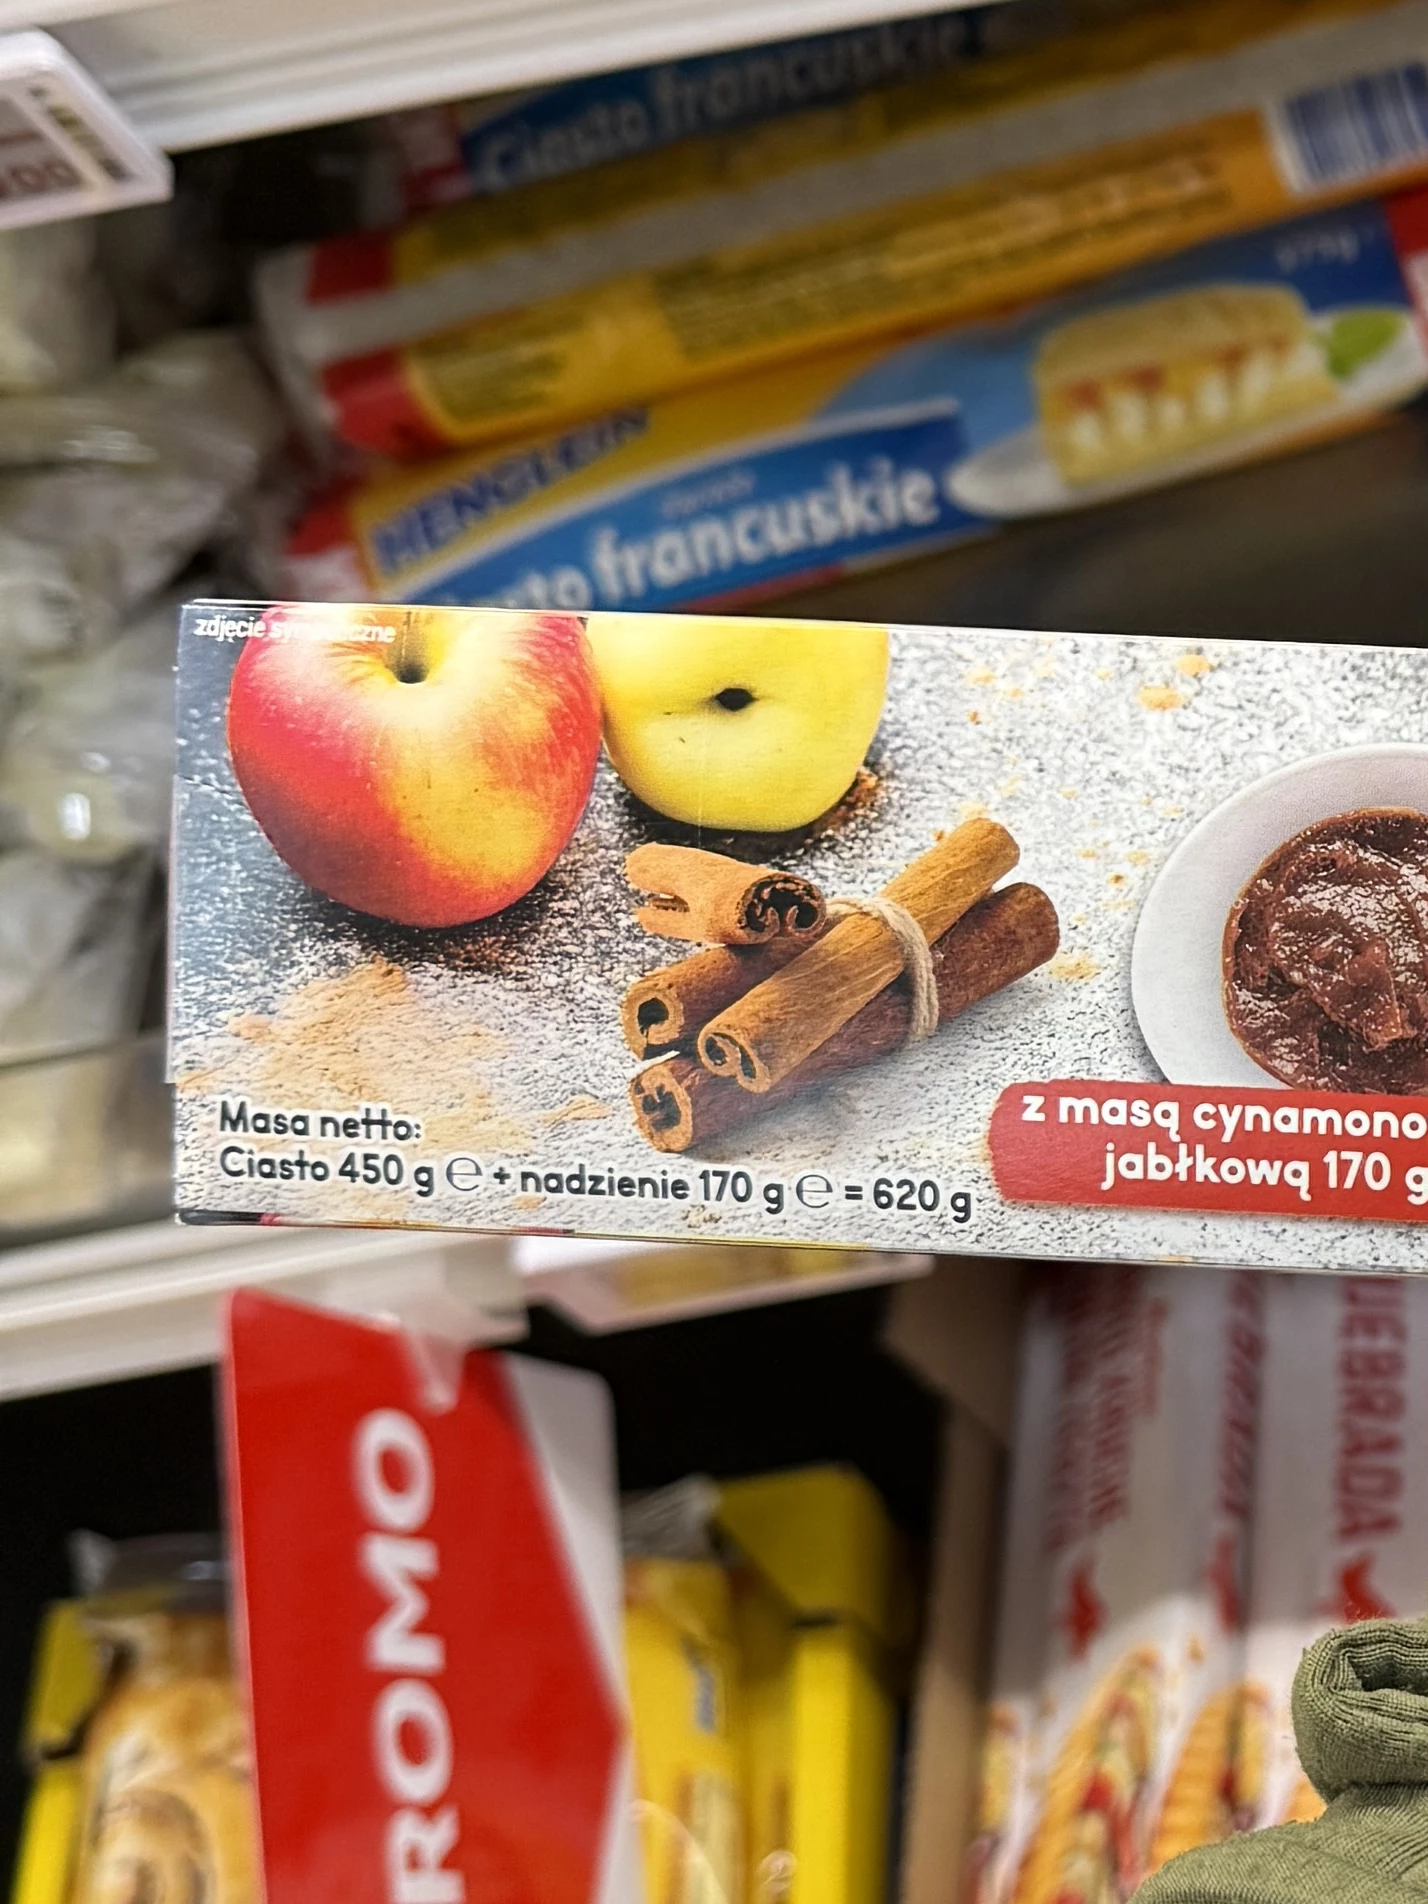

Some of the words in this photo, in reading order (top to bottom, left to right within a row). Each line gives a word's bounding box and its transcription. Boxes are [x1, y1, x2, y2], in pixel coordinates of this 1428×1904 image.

[594, 455, 942, 609] francuskie
[193, 615, 266, 643] zdjęcie
[219, 1100, 310, 1135] Masa
[320, 1107, 422, 1140] netto:
[1022, 1094, 1045, 1122] z
[1058, 1097, 1180, 1142] masą
[220, 1145, 329, 1181] Ciasto
[338, 1151, 404, 1186] 450
[413, 1166, 434, 1196] g
[520, 1163, 690, 1200] nadzienie
[699, 1169, 753, 1203] 170
[763, 1181, 785, 1214] g
[873, 1177, 938, 1212] 620
[950, 1190, 972, 1223] g
[1100, 1142, 1311, 1202] jabłkową
[1321, 1150, 1391, 1191] 170
